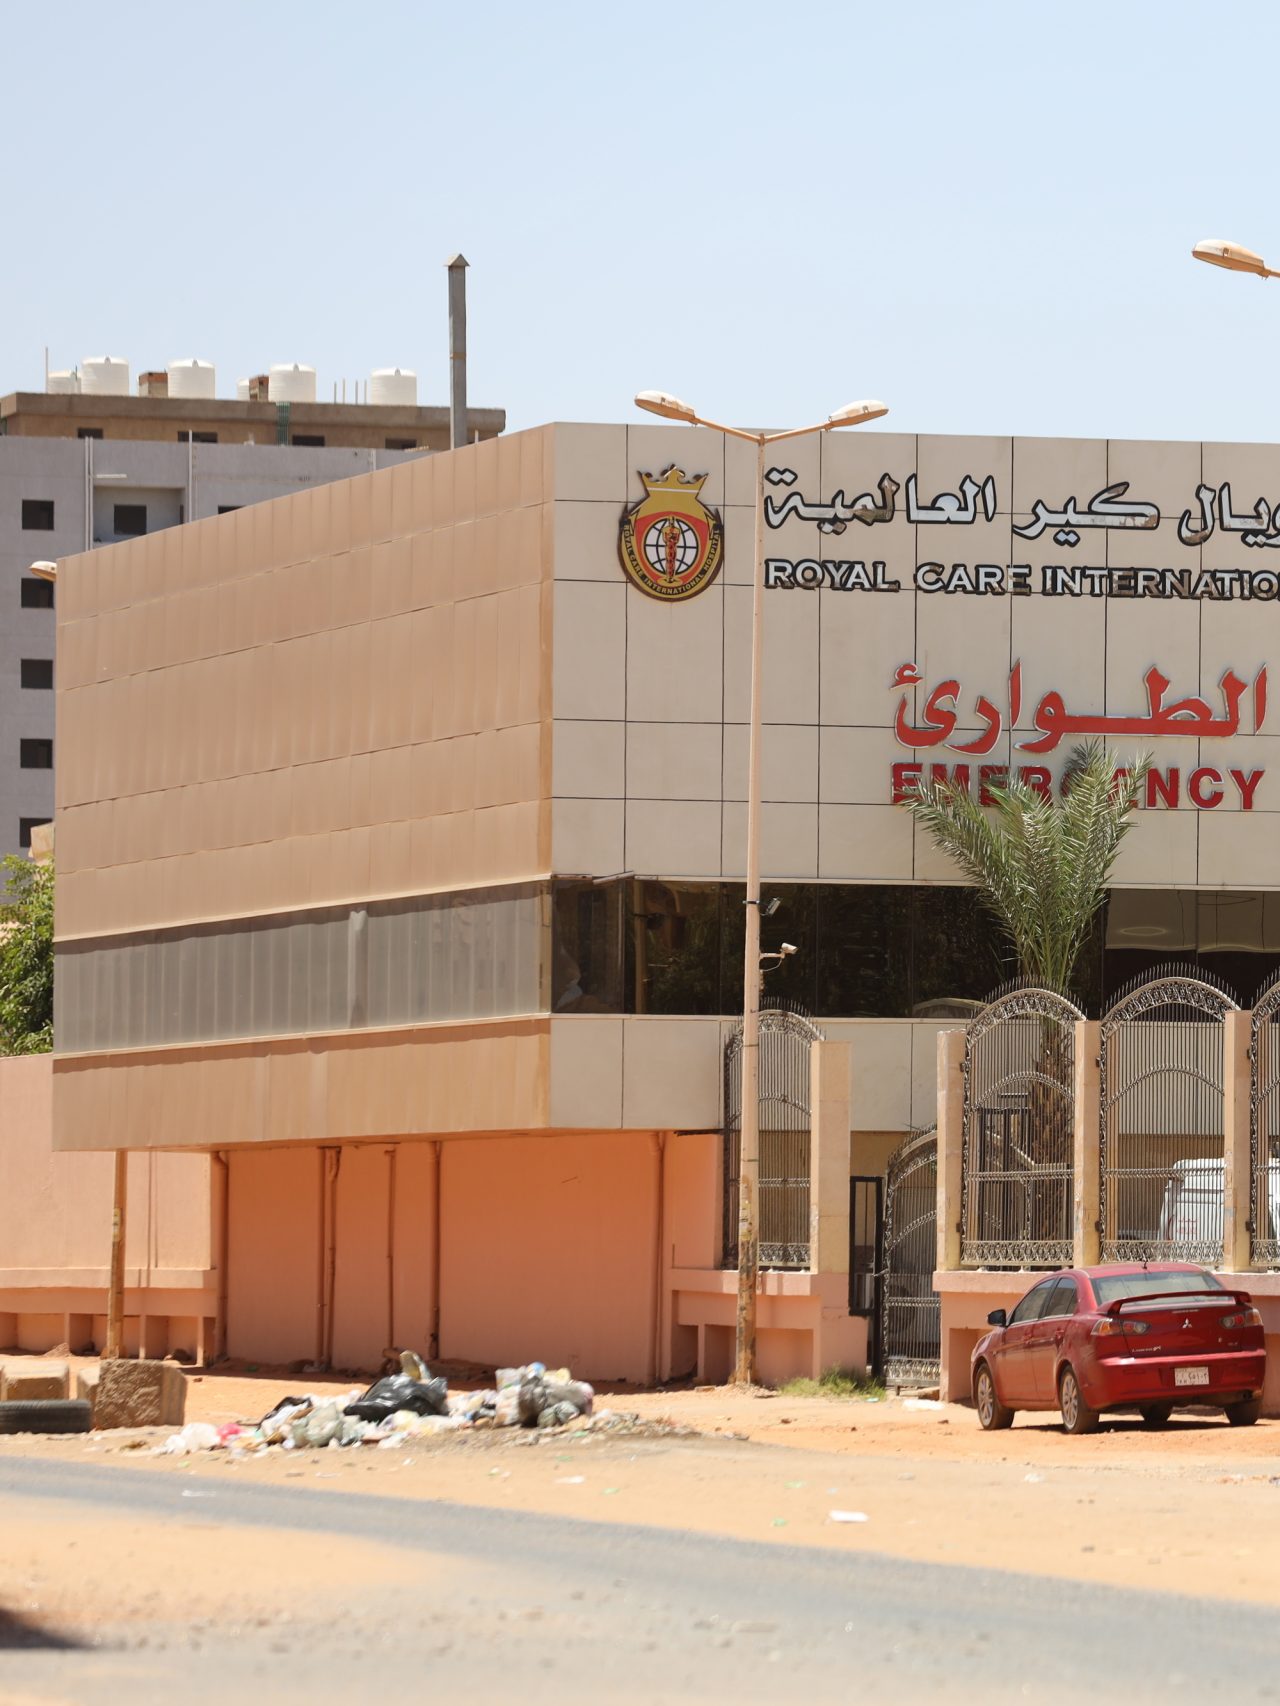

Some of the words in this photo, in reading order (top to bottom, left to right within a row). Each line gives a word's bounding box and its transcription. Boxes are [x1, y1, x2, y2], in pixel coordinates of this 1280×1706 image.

[764, 466, 998, 536] العالمية
[1012, 480, 1160, 546] كير
[624, 524, 634, 555] ROYAL
[630, 555, 643, 578] CARE
[644, 574, 704, 595] INTERNATIONAL
[703, 530, 720, 570] HOSPITAL
[764, 558, 901, 592] ROYAL
[915, 561, 1033, 597] CARE
[889, 658, 1268, 756] الطوارئ
